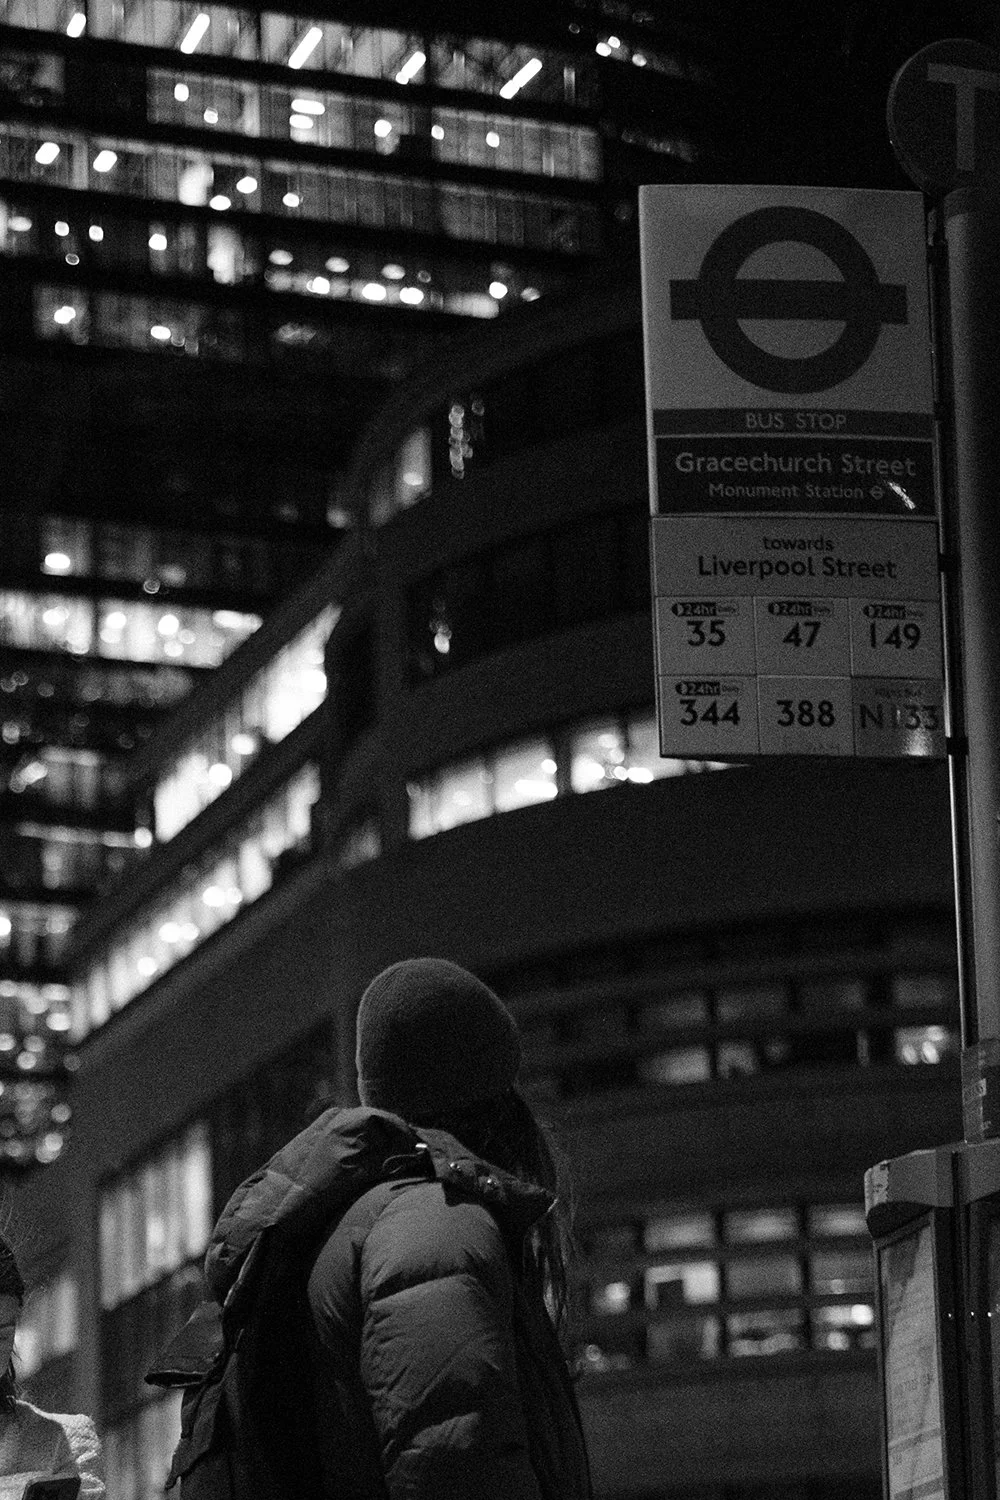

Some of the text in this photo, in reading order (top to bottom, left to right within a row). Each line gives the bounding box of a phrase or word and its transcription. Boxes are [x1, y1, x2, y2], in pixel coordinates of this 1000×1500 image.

[926, 62, 1000, 172] T
[745, 412, 847, 430] BUS STOP
[675, 452, 917, 476] Gracechurch Street
[708, 483, 864, 499] Monument Station
[763, 536, 834, 551] towards
[698, 555, 897, 579] Liverpool Street
[684, 603, 716, 616] 24hr
[779, 602, 812, 616] 24hr
[873, 605, 905, 619] 24hr
[687, 620, 726, 646] 35
[783, 622, 821, 647] 47
[869, 623, 921, 649] 149
[688, 682, 720, 696] 24hr
[679, 699, 740, 726] 344
[776, 700, 836, 726] 388
[860, 704, 939, 730] N133
